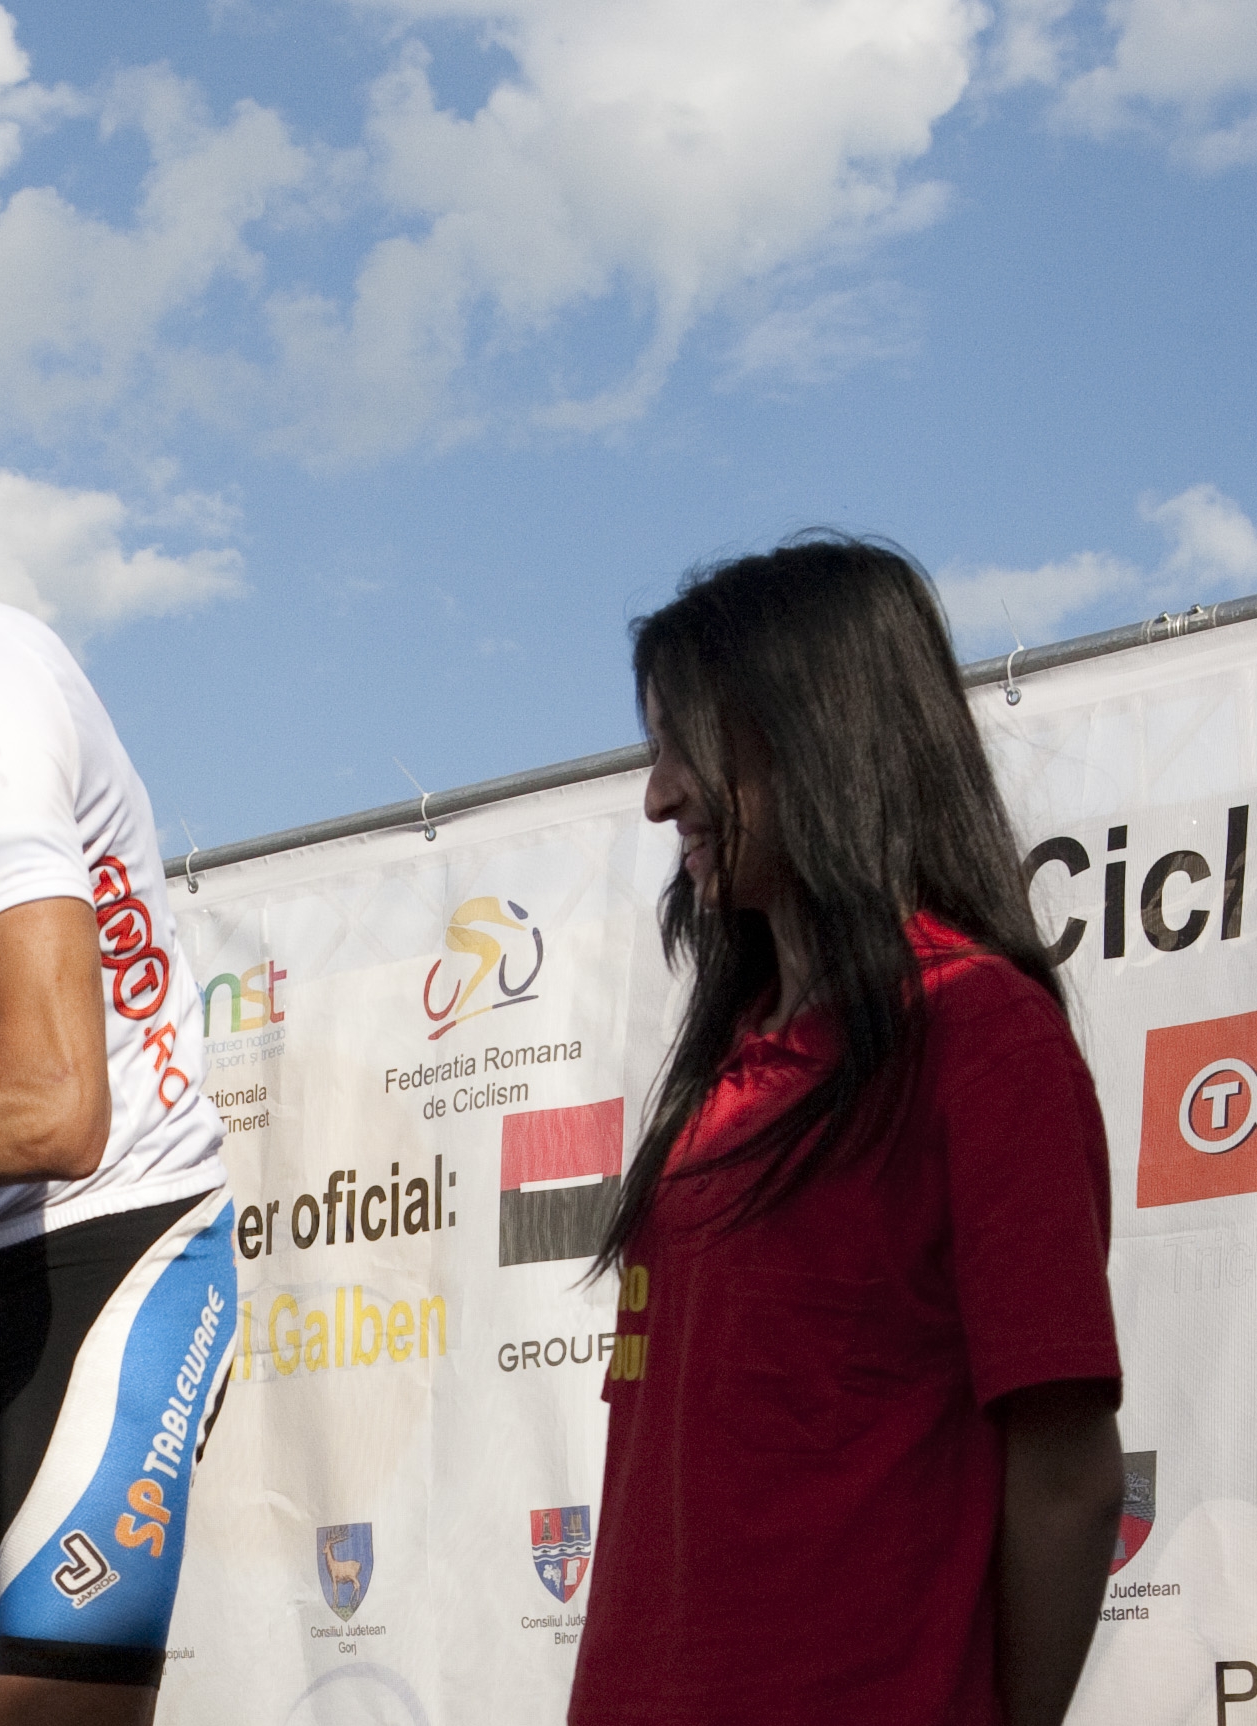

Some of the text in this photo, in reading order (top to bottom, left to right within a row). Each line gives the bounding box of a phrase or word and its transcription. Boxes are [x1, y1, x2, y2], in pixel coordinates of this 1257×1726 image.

[384, 1039, 583, 1094] Federatia Romana
[422, 1080, 530, 1122] de Ciclism
[290, 1154, 457, 1250] oficial:
[267, 1284, 448, 1377] Galben
[143, 1283, 226, 1481] TABLEWARE
[114, 1478, 172, 1558] SP
[1109, 1582, 1181, 1599] Judetean
[310, 1625, 386, 1639] Consiliul Judetean
[521, 1614, 563, 1629] Consiliul
[554, 1632, 578, 1645] Bihor
[338, 1641, 357, 1656] Gorj
